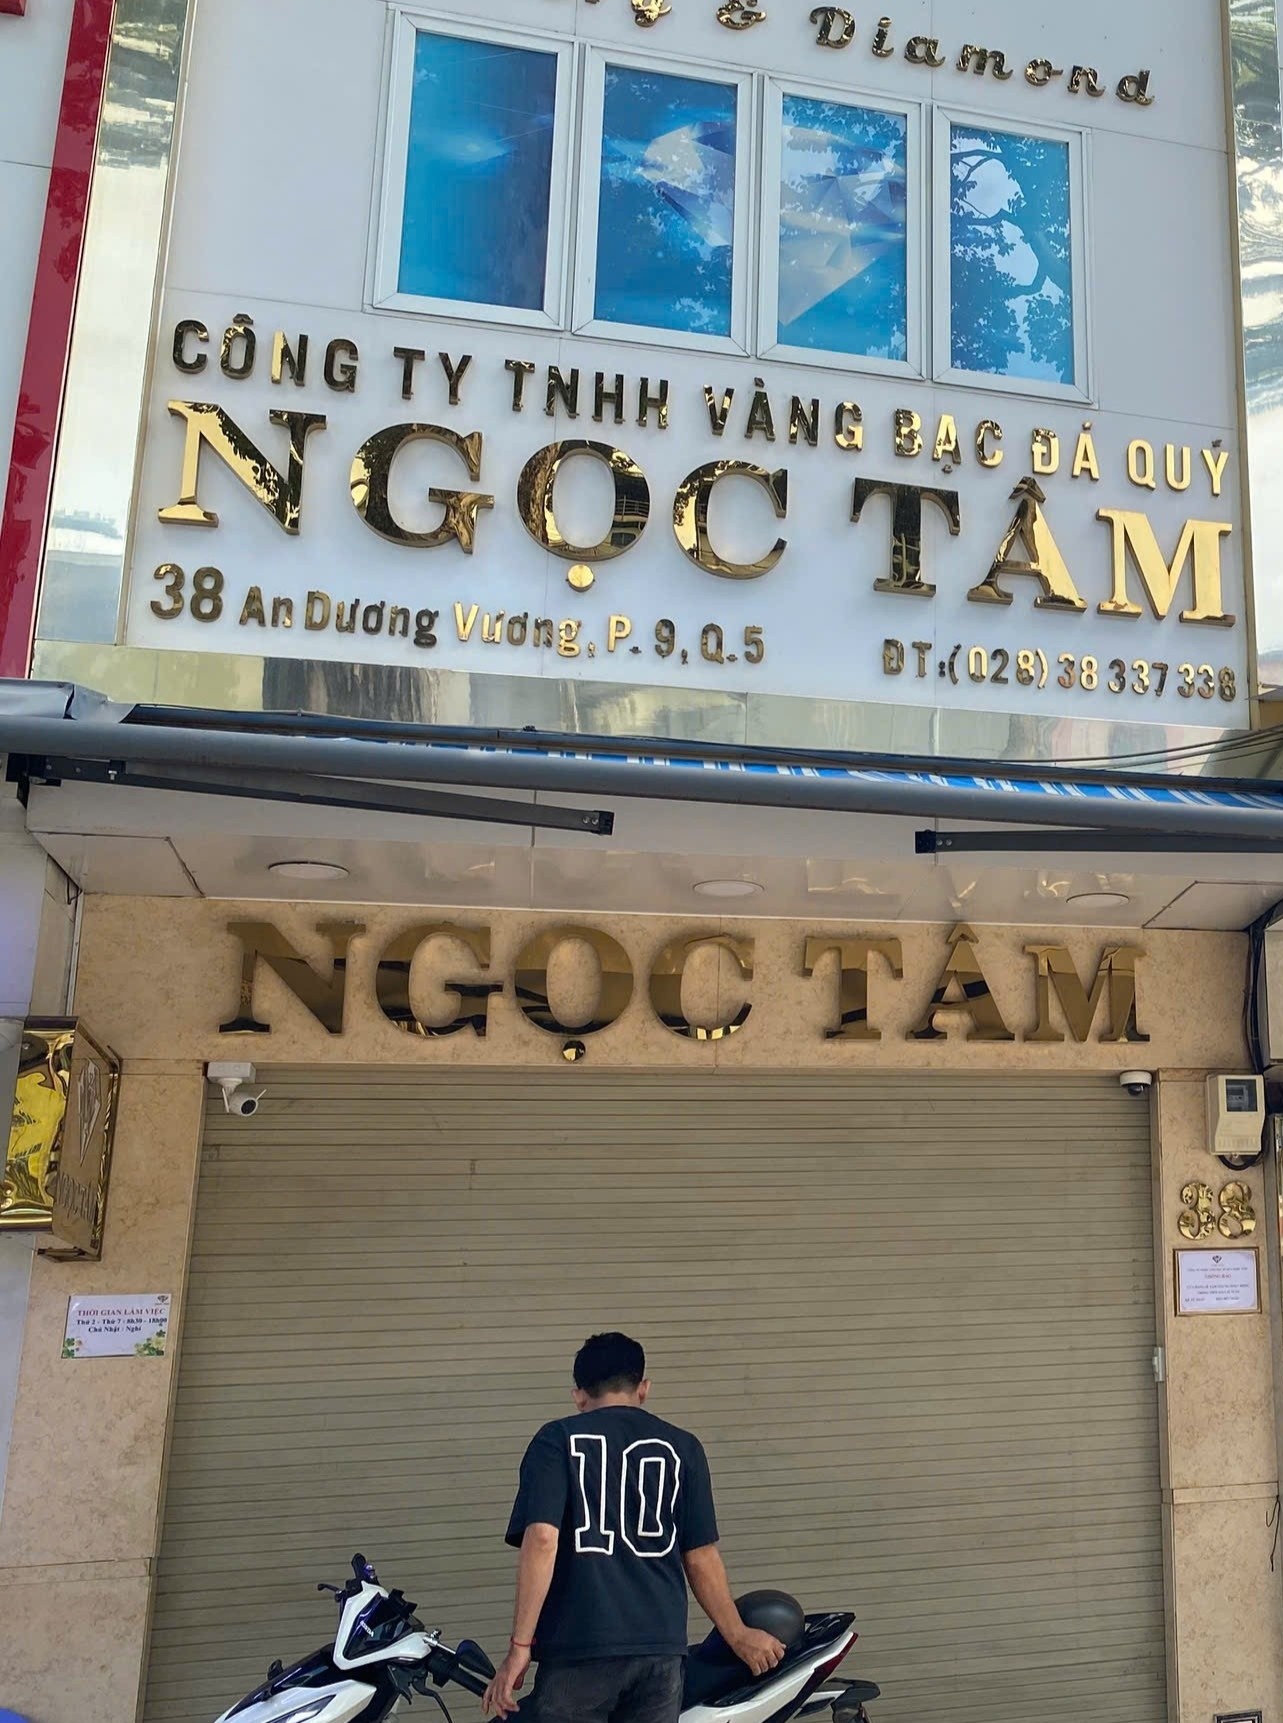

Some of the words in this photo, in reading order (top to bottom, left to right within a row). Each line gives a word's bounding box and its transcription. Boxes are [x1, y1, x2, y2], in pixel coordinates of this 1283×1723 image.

[809, 6, 1155, 106] Diamond
[172, 313, 359, 393] CÔNG
[393, 346, 472, 406] TY
[504, 359, 669, 430] TNHH
[703, 377, 864, 451] VÀNG
[894, 408, 1003, 474] BẠC
[1031, 421, 1100, 481] ĐÁ
[1127, 438, 1230, 496] QUÝ
[158, 400, 788, 593] NGỌC
[849, 475, 1236, 627] TÂM
[150, 563, 224, 623] 38
[239, 585, 294, 628] An
[304, 590, 440, 648] Dương
[453, 601, 596, 659] Vương,
[1177, 663, 1237, 702] 338
[219, 920, 755, 1061] NGỌC
[804, 921, 1151, 1042] TÂM
[1177, 1180, 1257, 1240] 38
[100, 1308, 122, 1317] GIAN
[570, 1434, 681, 1557] 10
